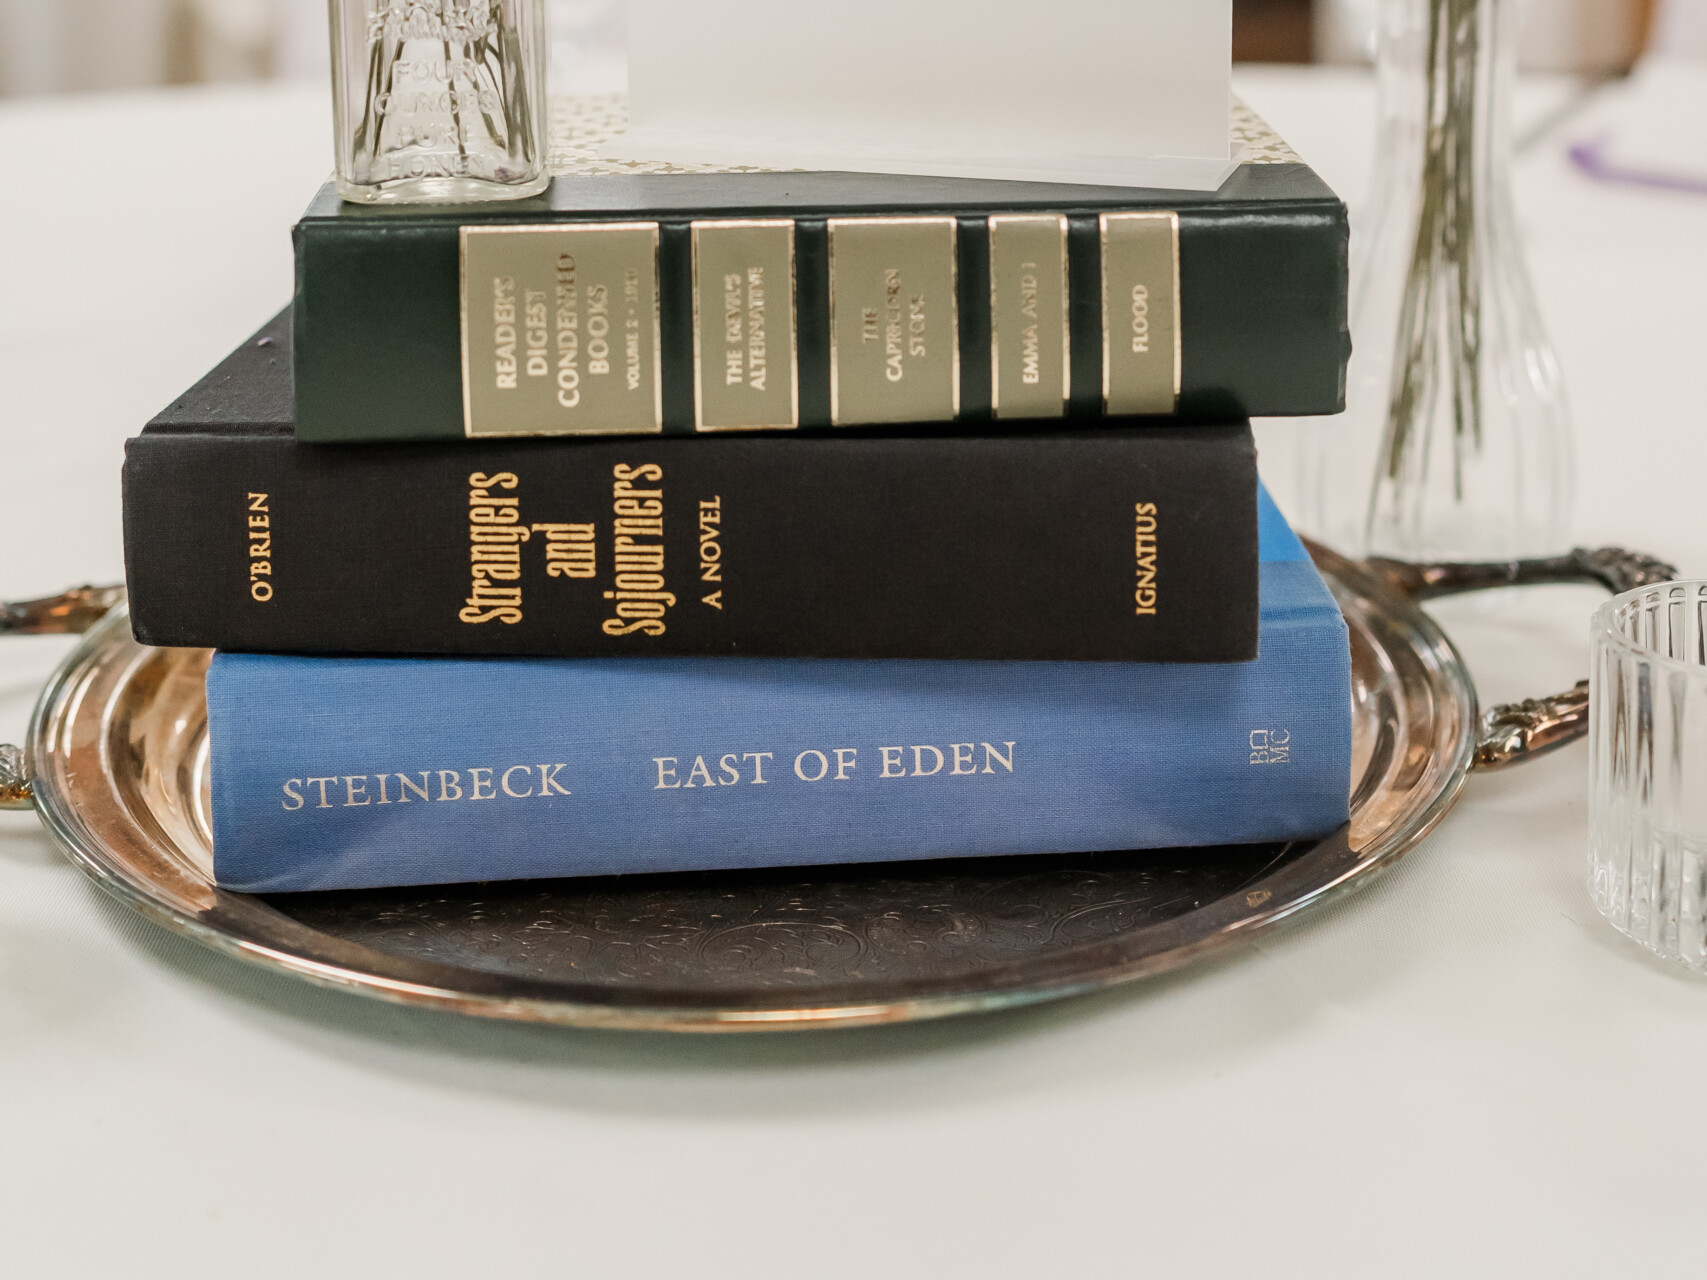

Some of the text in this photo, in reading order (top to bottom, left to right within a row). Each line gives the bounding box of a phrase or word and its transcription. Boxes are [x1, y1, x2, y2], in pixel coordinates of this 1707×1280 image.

[374, 91, 497, 115] OUNCES
[395, 59, 477, 83] FOUR
[494, 275, 517, 389] READER'S
[525, 290, 548, 377] DIGEST
[556, 253, 580, 408] CONDENSED
[587, 284, 610, 376] BOOKS
[747, 266, 766, 391] ALTERNATIVE
[861, 307, 879, 344] THE
[885, 269, 903, 382] CAPRICORN
[1021, 273, 1038, 318] AND
[1132, 284, 1149, 353] FLOOD
[624, 332, 640, 390] VOLUME
[725, 349, 743, 386] THE
[1022, 324, 1040, 384] EMMA
[247, 492, 273, 602] O'BRIEN
[458, 471, 531, 625] Strangers
[531, 522, 597, 579] and
[602, 463, 676, 636] Sojourners
[699, 495, 723, 610] A NOVEL
[1135, 502, 1157, 615] IGNATIUS
[280, 762, 572, 811] STEINBECK
[652, 741, 1018, 790] EAST OF EDEN
